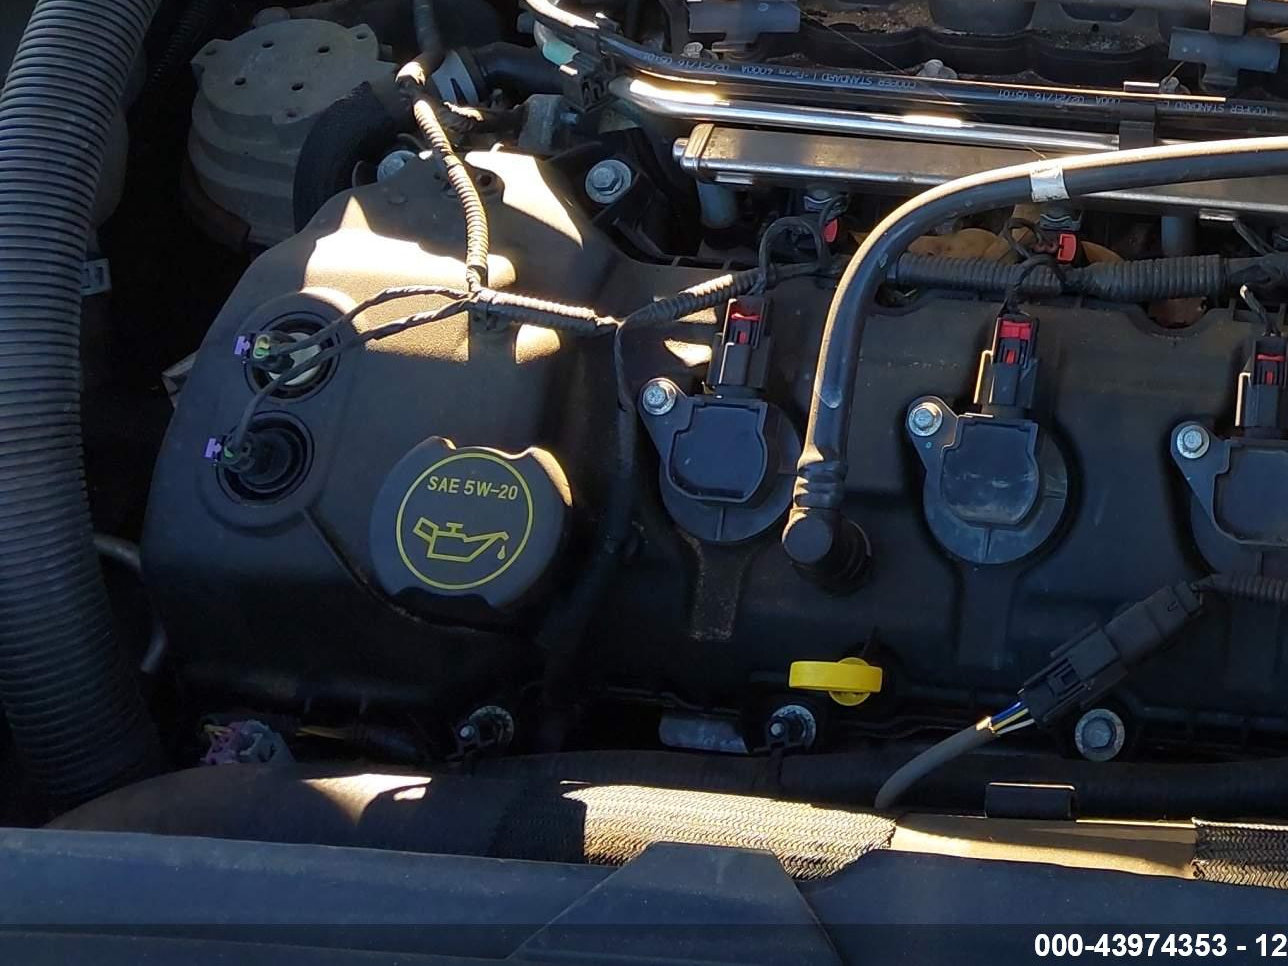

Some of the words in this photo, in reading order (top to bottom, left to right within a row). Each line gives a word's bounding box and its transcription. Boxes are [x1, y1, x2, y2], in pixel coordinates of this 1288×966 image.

[821, 72, 873, 86] STANDARD
[878, 77, 918, 90] COOPER
[1035, 91, 1086, 105] 02/21/16
[1174, 100, 1226, 114] STANDARD
[427, 475, 461, 494] SAE
[463, 479, 519, 501] 5W-20
